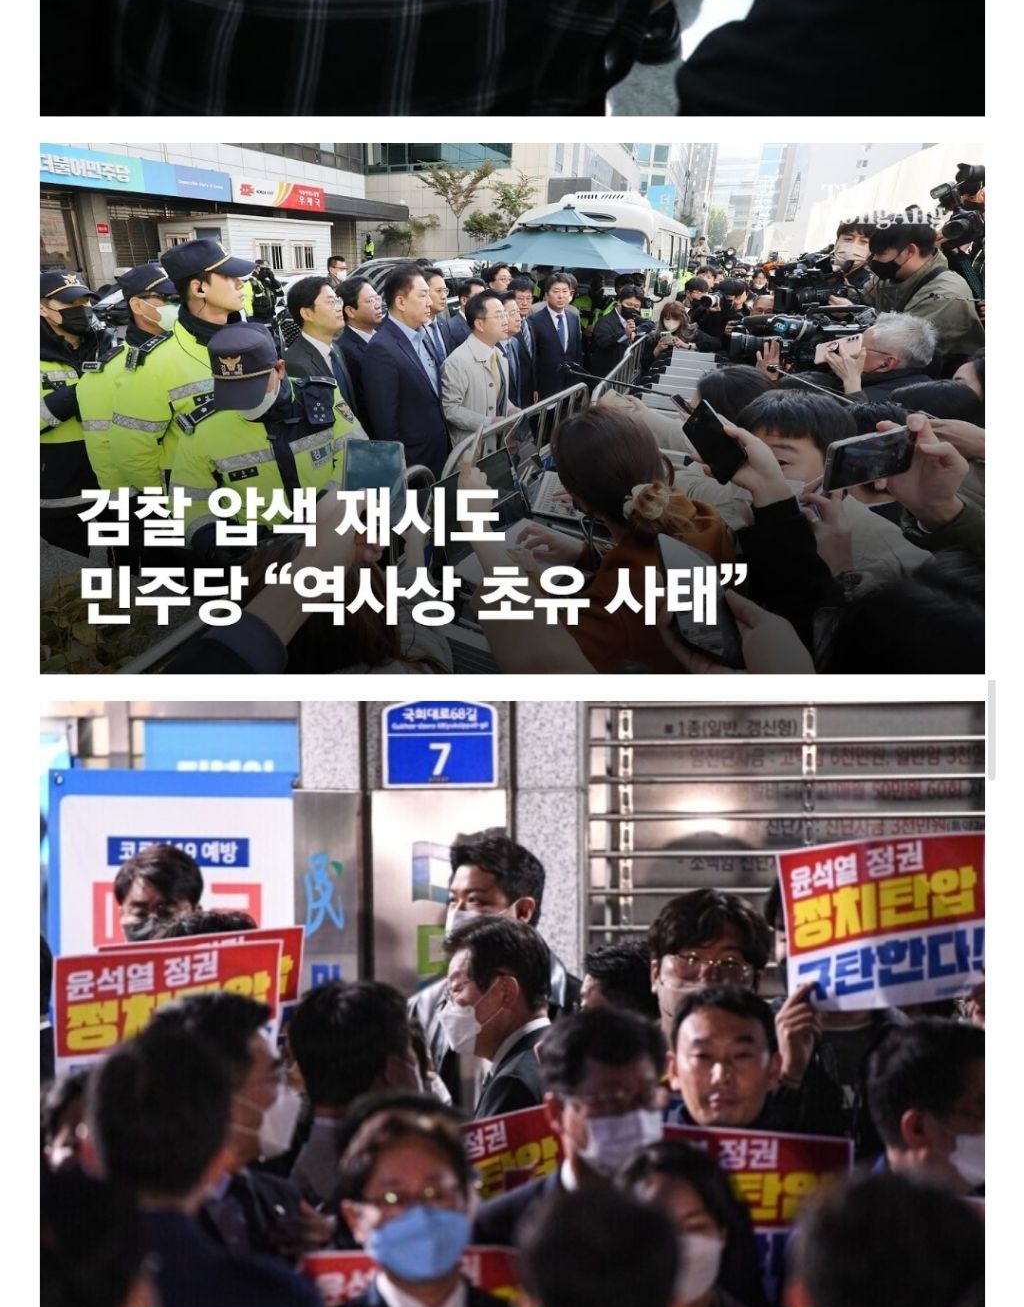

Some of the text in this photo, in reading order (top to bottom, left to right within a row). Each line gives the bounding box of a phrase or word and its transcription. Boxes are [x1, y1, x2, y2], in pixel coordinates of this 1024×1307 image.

[402, 707, 478, 722] 국회대로68길
[428, 742, 452, 776] 7
[201, 841, 238, 864] 예방
[790, 840, 924, 900] 윤석열 정권
[793, 865, 977, 950] 정치탄압
[66, 950, 219, 1002] 윤석열 정권
[719, 1138, 780, 1170] 정권
